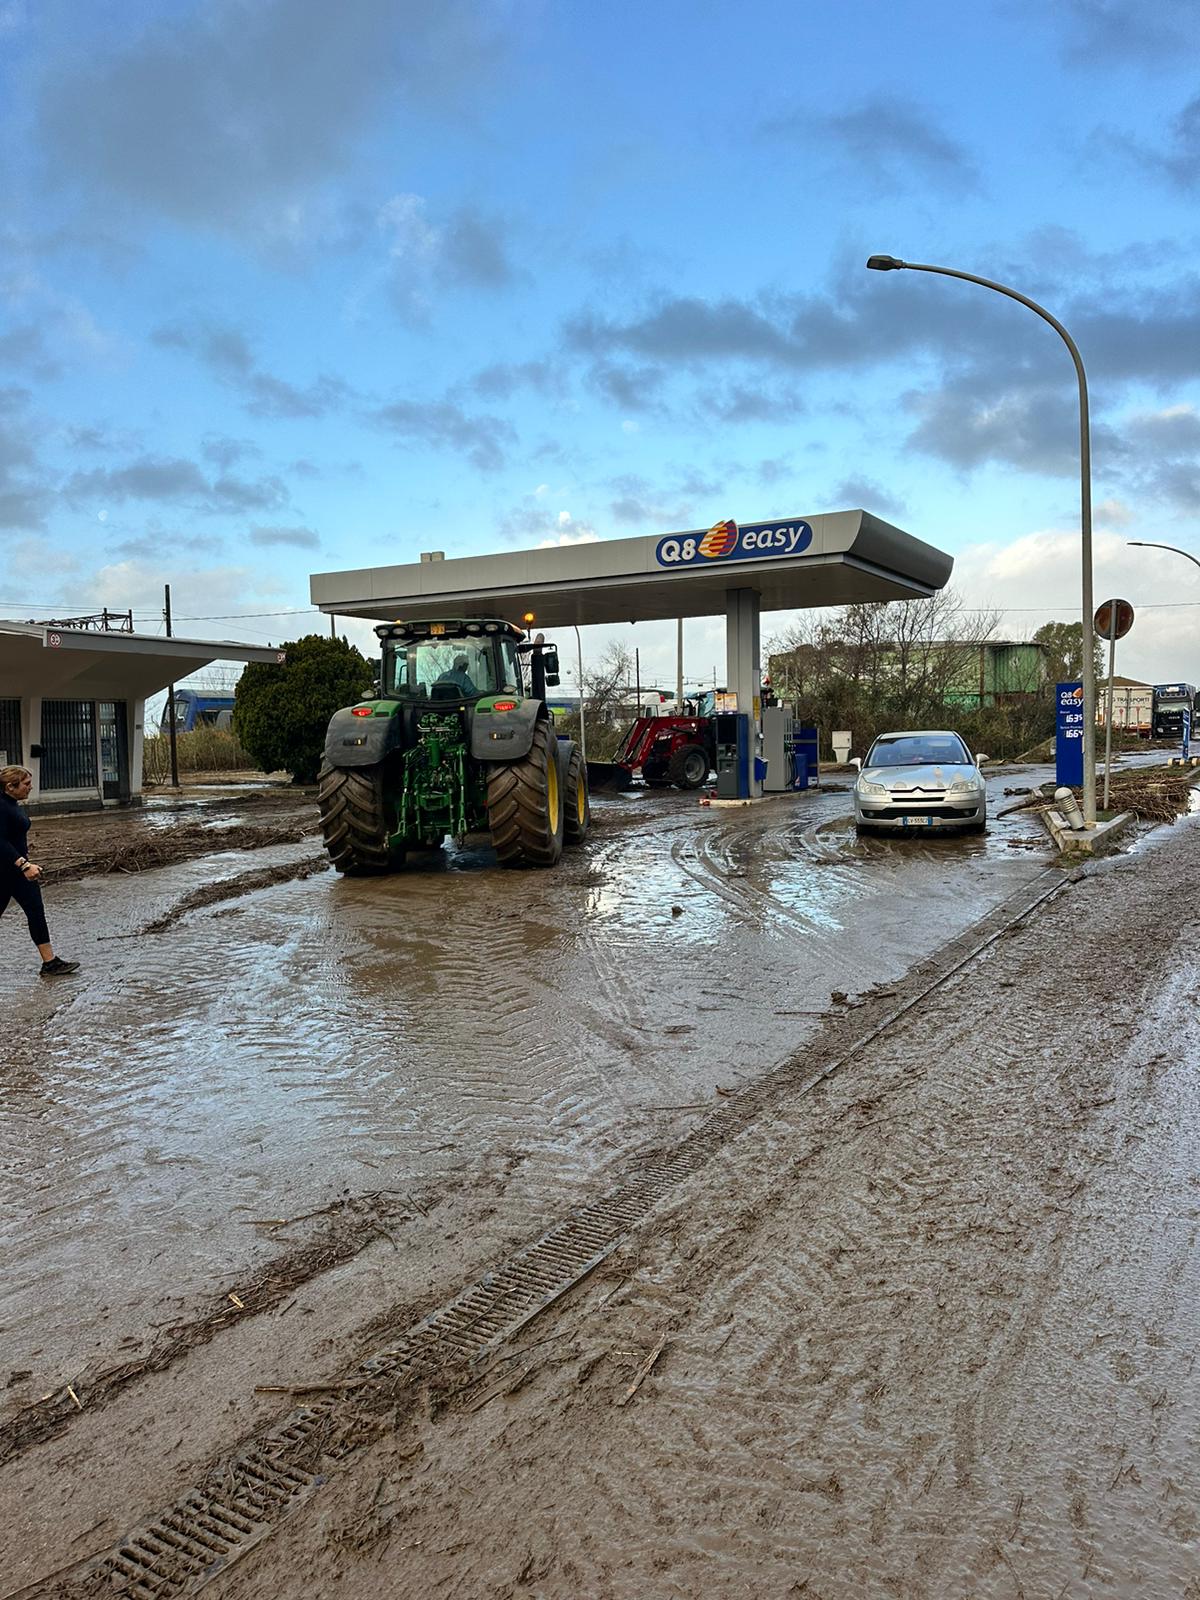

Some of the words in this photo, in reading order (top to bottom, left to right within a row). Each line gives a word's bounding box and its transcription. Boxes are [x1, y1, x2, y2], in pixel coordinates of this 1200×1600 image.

[661, 539, 696, 562] Q8
[742, 526, 805, 552] easy
[1060, 698, 1084, 707] easy
